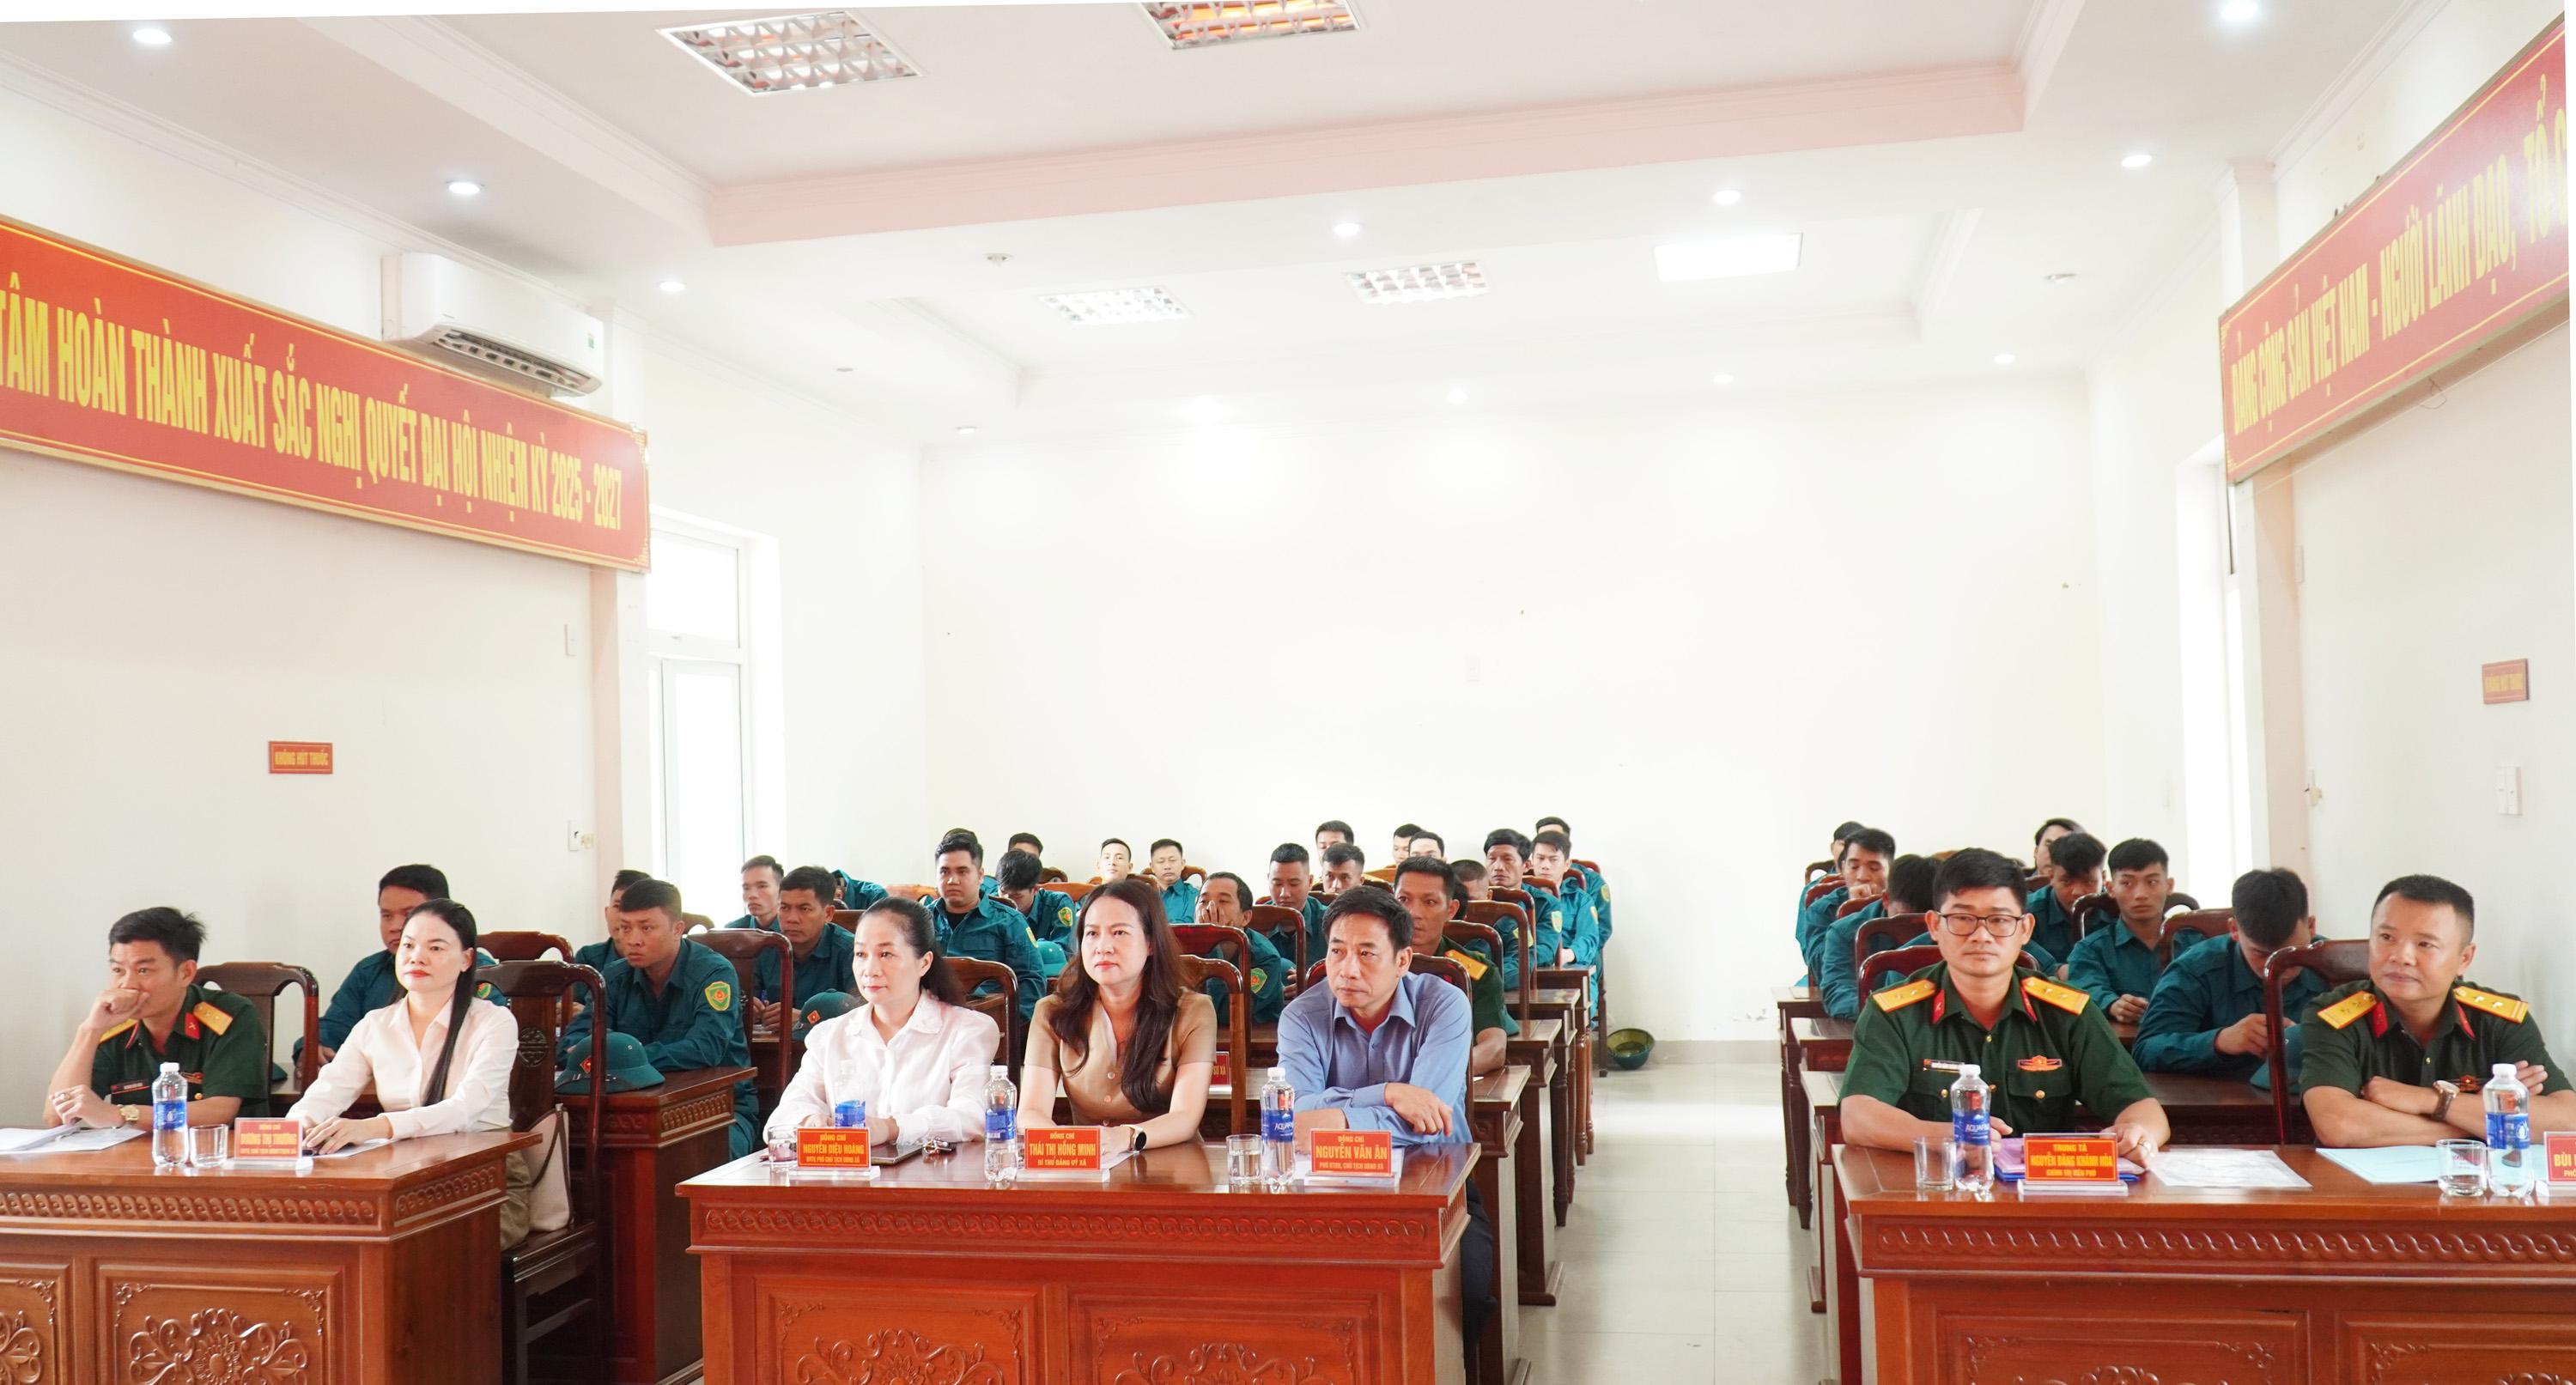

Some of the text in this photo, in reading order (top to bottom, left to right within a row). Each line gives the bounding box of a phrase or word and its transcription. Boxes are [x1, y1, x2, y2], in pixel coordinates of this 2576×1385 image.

[2312, 274, 2336, 397] VIỆT
[2339, 263, 2370, 368] NAM
[2524, 74, 2550, 244] TỔ
[57, 297, 126, 416] HOÀN
[131, 318, 208, 434] THÀNH
[213, 333, 266, 448] XUẤT
[272, 343, 312, 460] SẮC
[315, 382, 362, 489] NGHỊ
[365, 383, 417, 484] QUYẾT
[421, 413, 449, 507] ĐẠI
[452, 410, 478, 513] HỘI
[481, 422, 528, 522] NHIỆM
[531, 432, 548, 513] KỲ
[552, 451, 583, 522] 2025
[593, 463, 623, 531] 2027
[836, 1133, 847, 1141] CHÍ
[1050, 1131, 1065, 1139] ĐỒNG
[1338, 1134, 1364, 1143] ĐỒNG CHÍ
[1030, 1139, 1097, 1158] THÁI THỊ HỒNG MINH
[1315, 1142, 1352, 1159] NGUYỄN
[1354, 1144, 1372, 1159] VĂN
